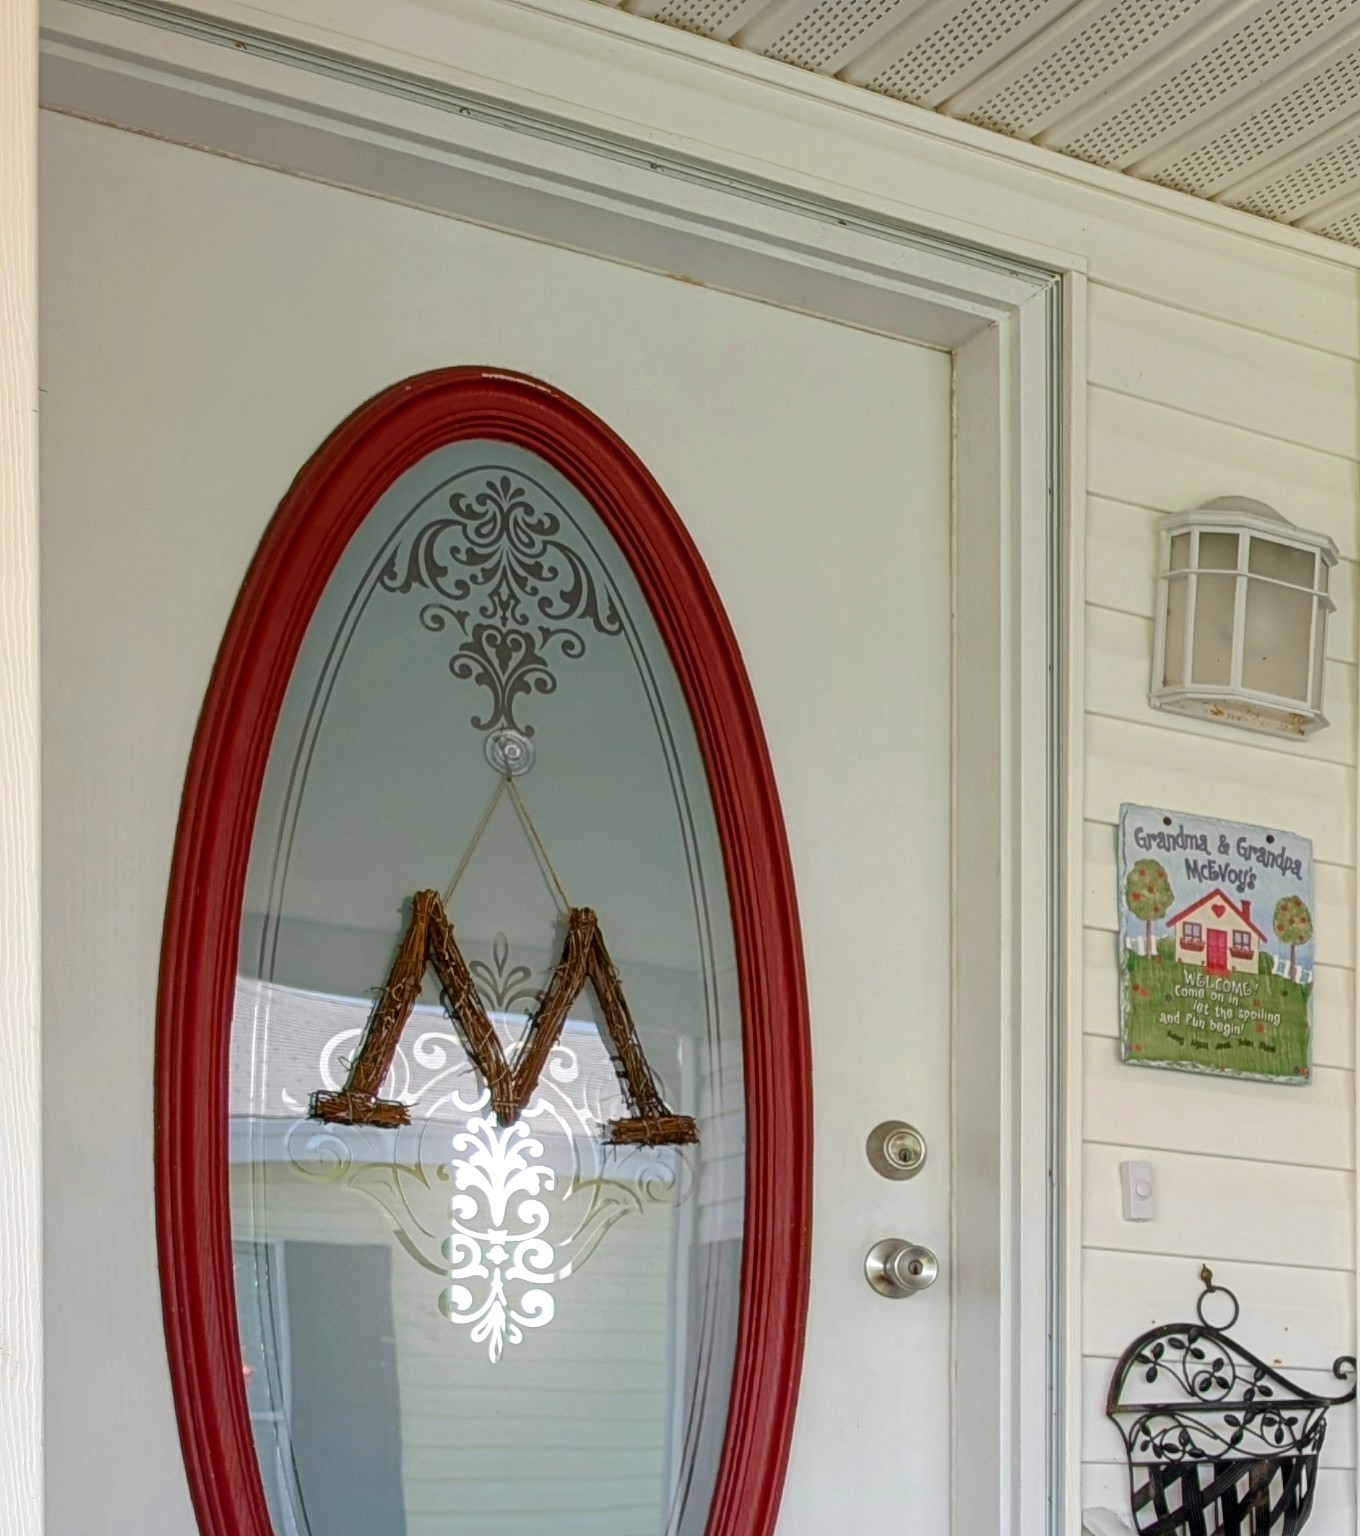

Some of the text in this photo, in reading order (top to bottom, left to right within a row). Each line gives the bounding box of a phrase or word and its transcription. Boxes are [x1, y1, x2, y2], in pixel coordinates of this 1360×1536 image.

[1134, 825, 1303, 881] Grandma & Grandpa
[1174, 985, 1239, 1006] Come on in
[1183, 969, 1259, 997] WELCOME!
[1159, 1011, 1245, 1038] and fun begin!
[1193, 1000, 1281, 1027] let the spoiling
